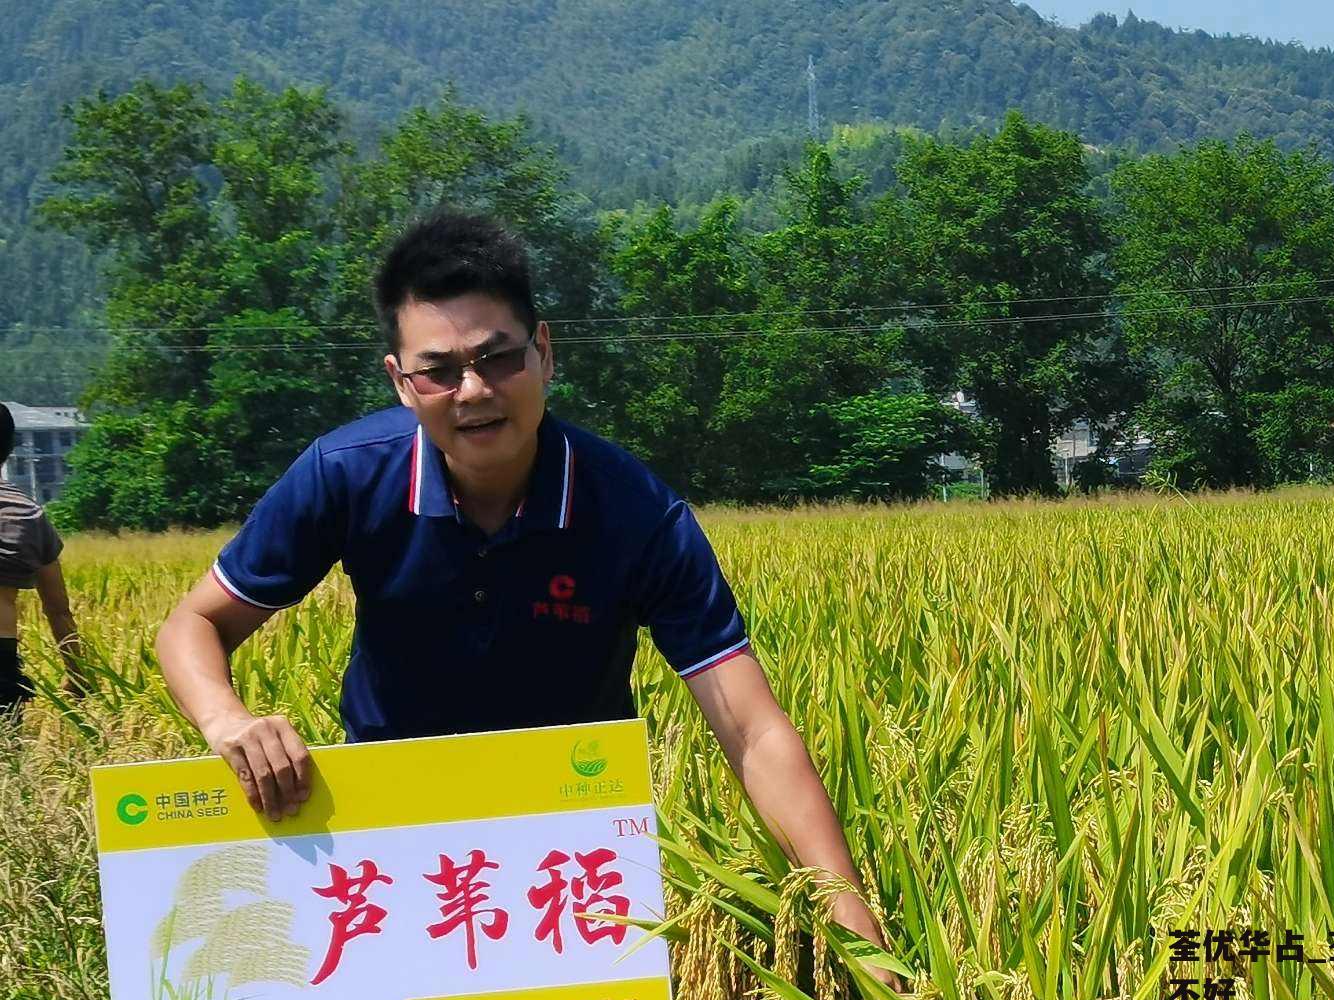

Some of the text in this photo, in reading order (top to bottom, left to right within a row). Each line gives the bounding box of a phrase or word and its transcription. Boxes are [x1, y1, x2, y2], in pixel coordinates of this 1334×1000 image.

[155, 788, 228, 810] 中国种子
[156, 806, 229, 821] CHINA SEED
[612, 816, 649, 837] TM
[310, 846, 632, 986] 芦苇稻
